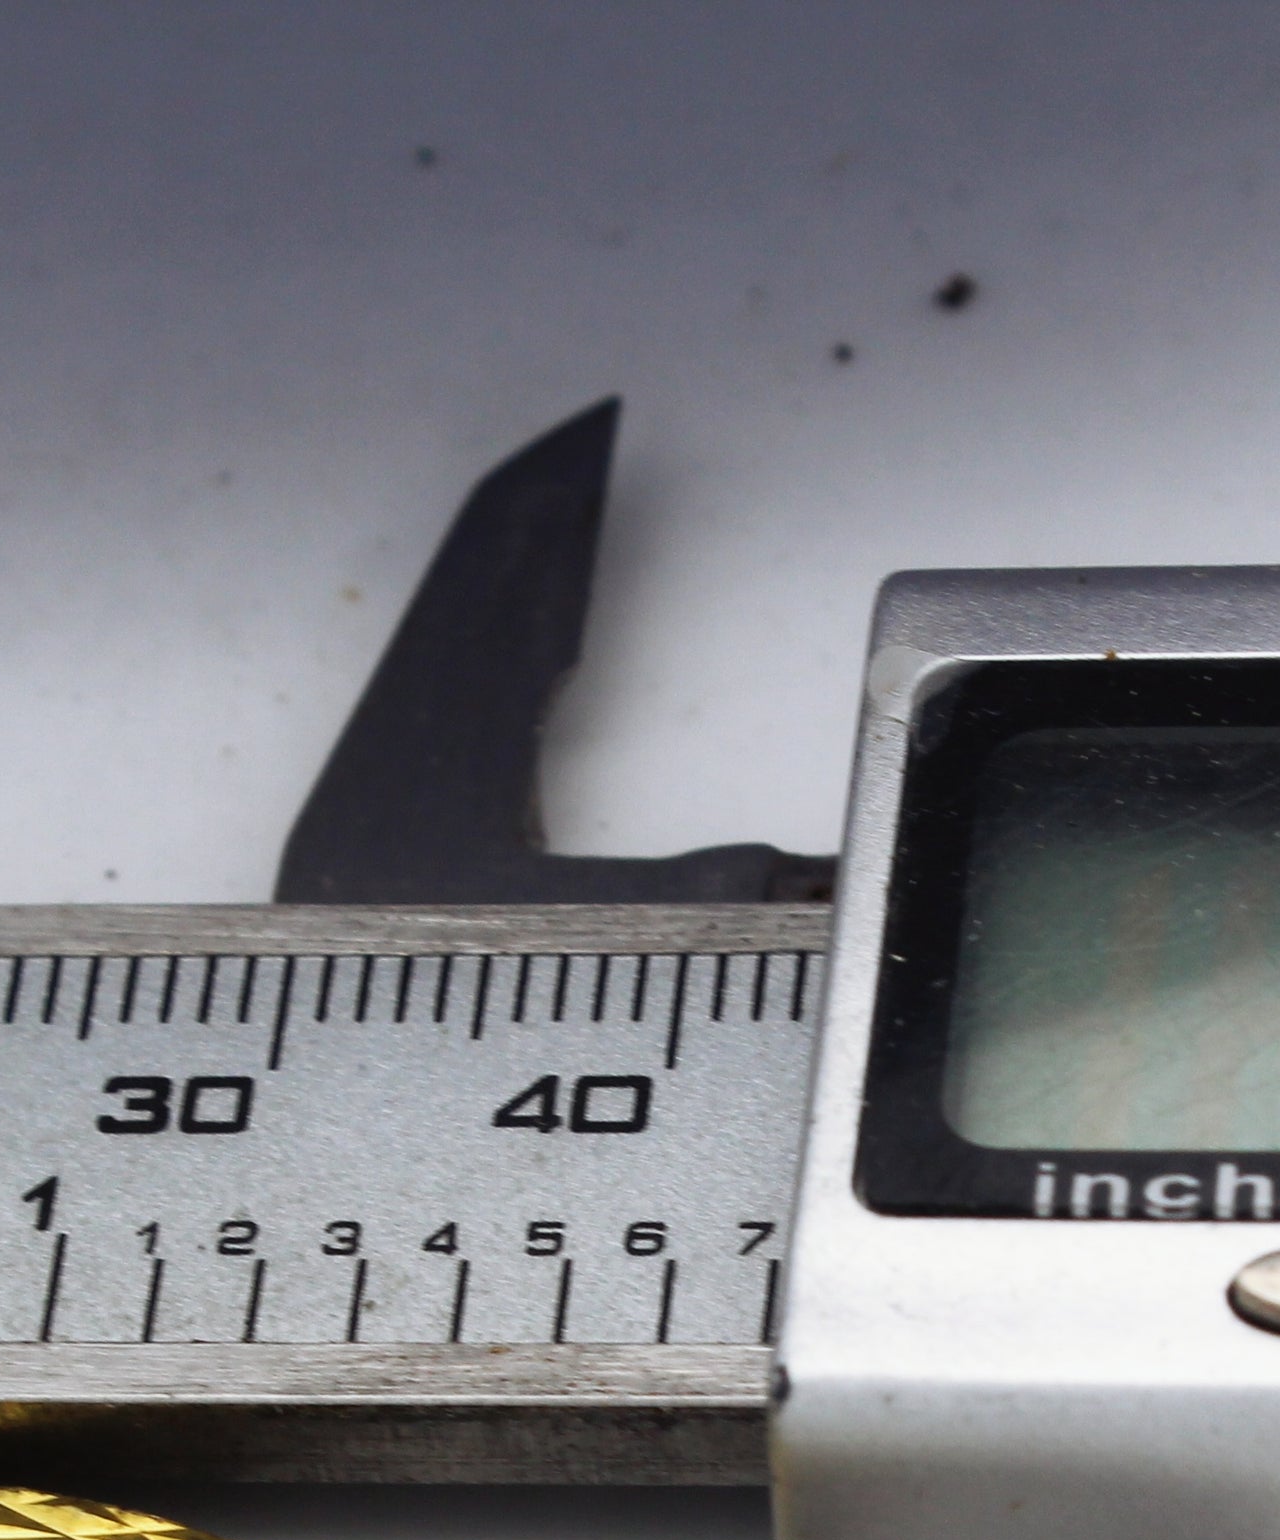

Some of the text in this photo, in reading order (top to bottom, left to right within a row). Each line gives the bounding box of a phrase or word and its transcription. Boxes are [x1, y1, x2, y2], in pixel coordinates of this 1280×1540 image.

[94, 1074, 257, 1136] 30
[489, 1073, 655, 1136] 40
[19, 1173, 61, 1233] 1
[134, 1219, 161, 1257] 1
[215, 1218, 261, 1258] 2
[320, 1219, 363, 1258] 3
[421, 1219, 460, 1257] 4
[523, 1219, 567, 1258] 5
[622, 1219, 670, 1258] 6
[737, 1219, 778, 1257] 7
